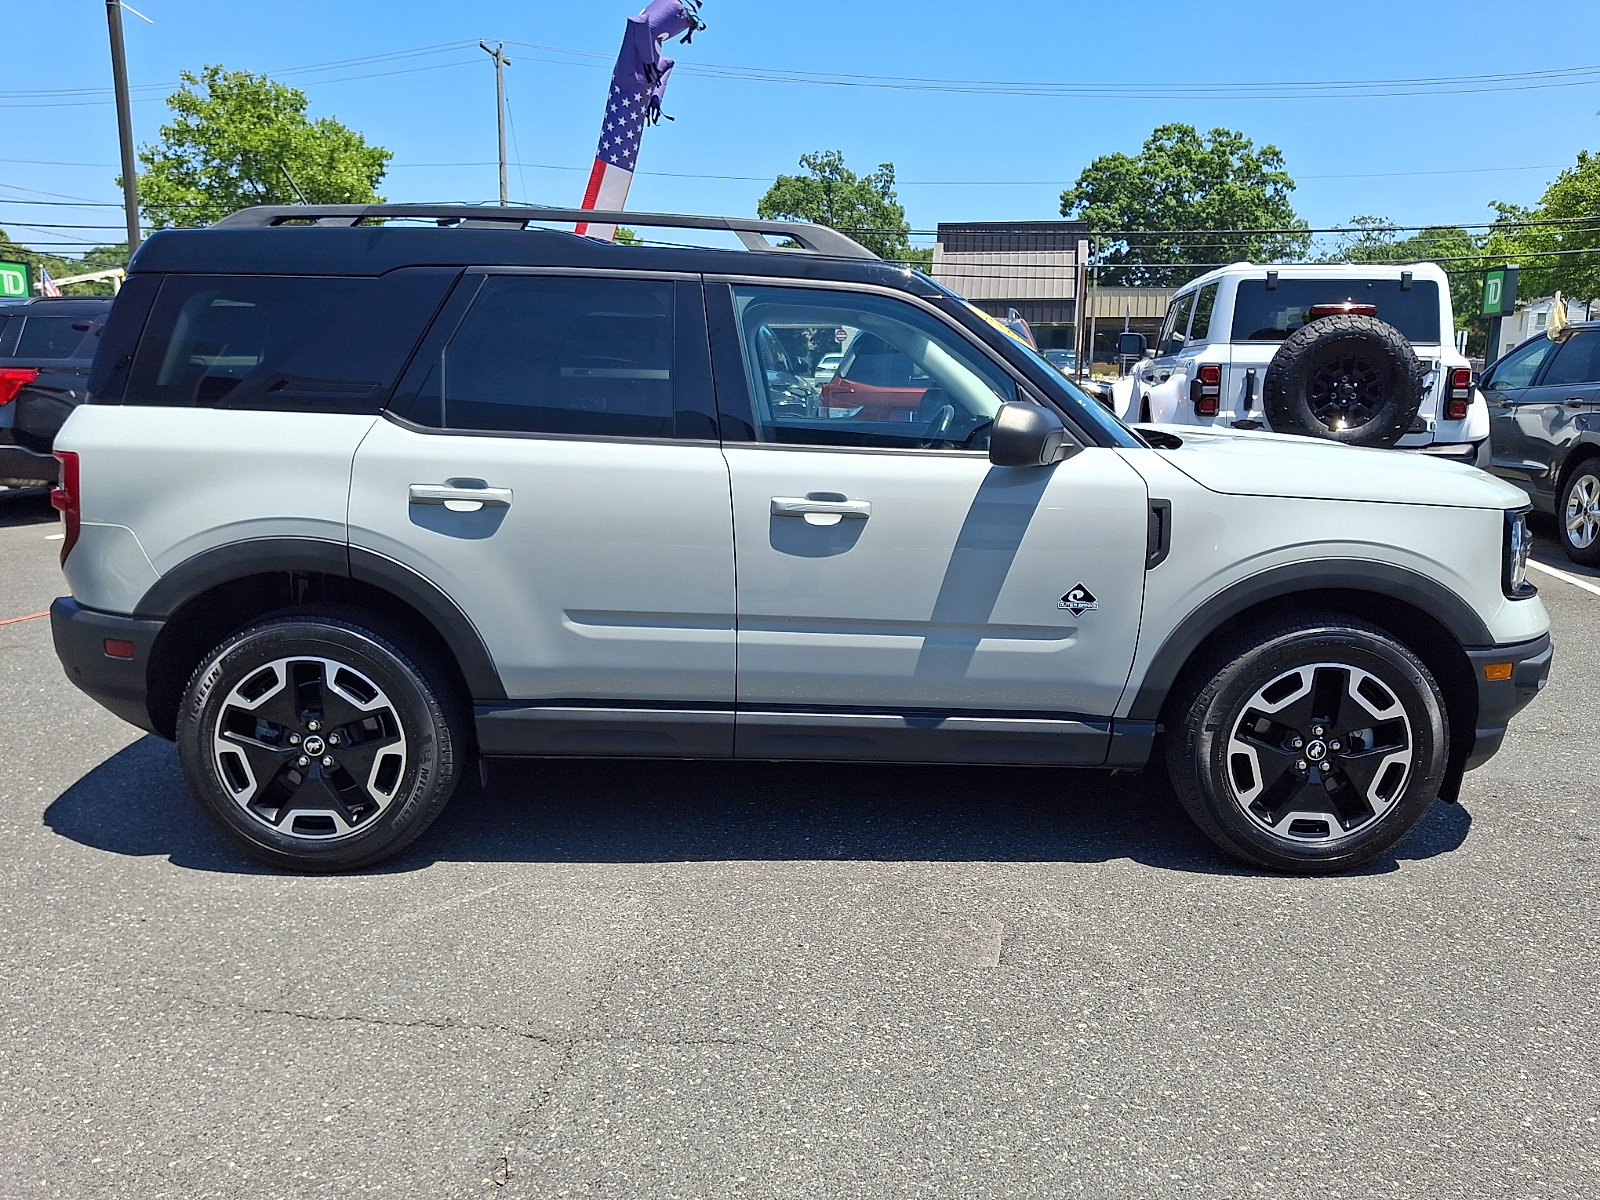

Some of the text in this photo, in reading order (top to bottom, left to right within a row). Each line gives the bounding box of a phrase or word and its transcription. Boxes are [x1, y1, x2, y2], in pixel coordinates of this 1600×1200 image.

[0, 269, 25, 295] TD
[1488, 278, 1502, 304] TD
[189, 667, 220, 723] ICHELIN
